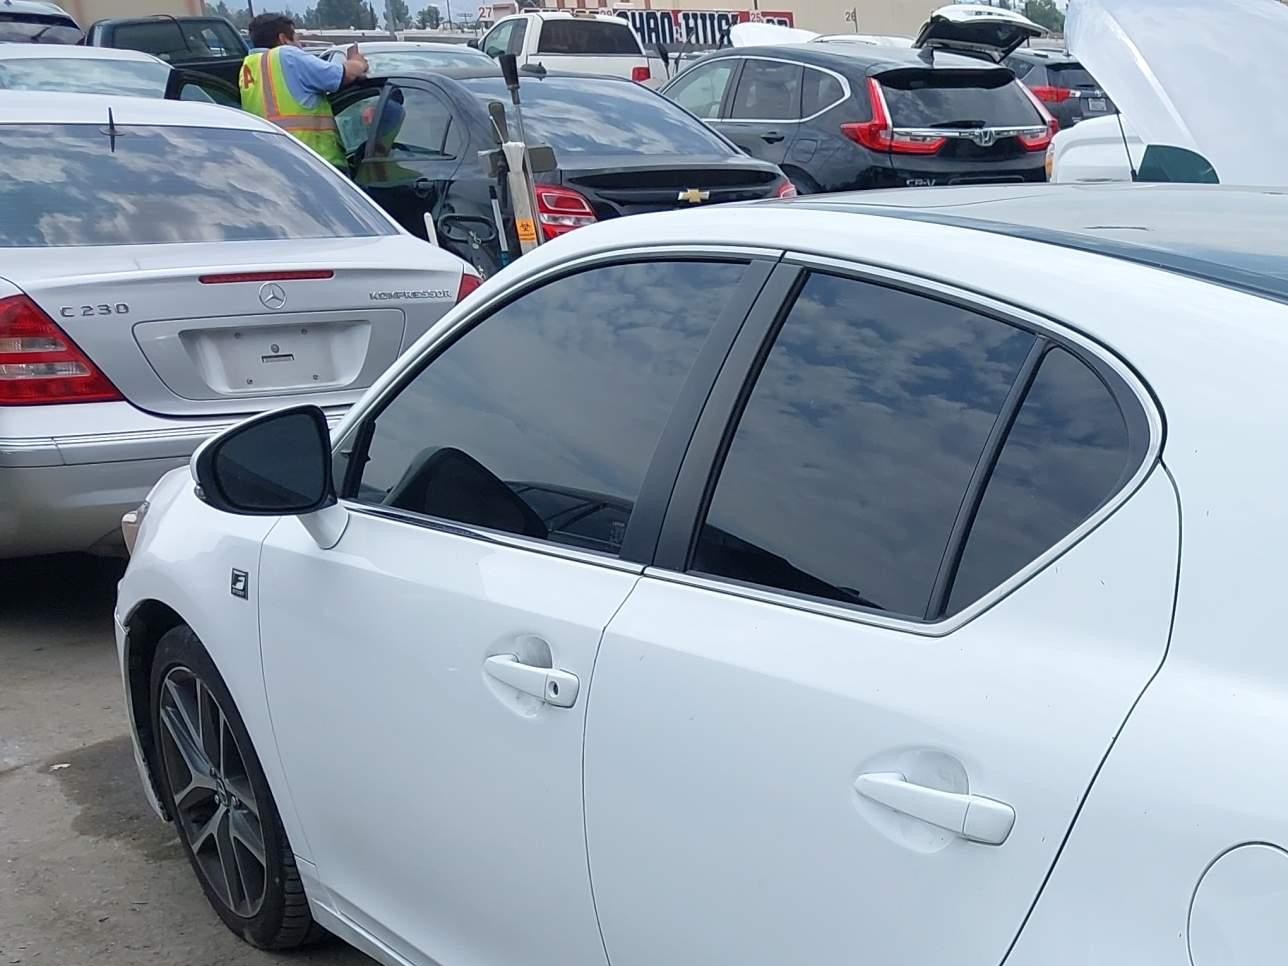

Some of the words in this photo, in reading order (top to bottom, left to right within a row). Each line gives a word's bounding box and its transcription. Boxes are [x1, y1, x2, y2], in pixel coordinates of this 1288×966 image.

[369, 288, 452, 300] KOMPRESSOR
[59, 305, 76, 318] C
[80, 303, 129, 317] 230
